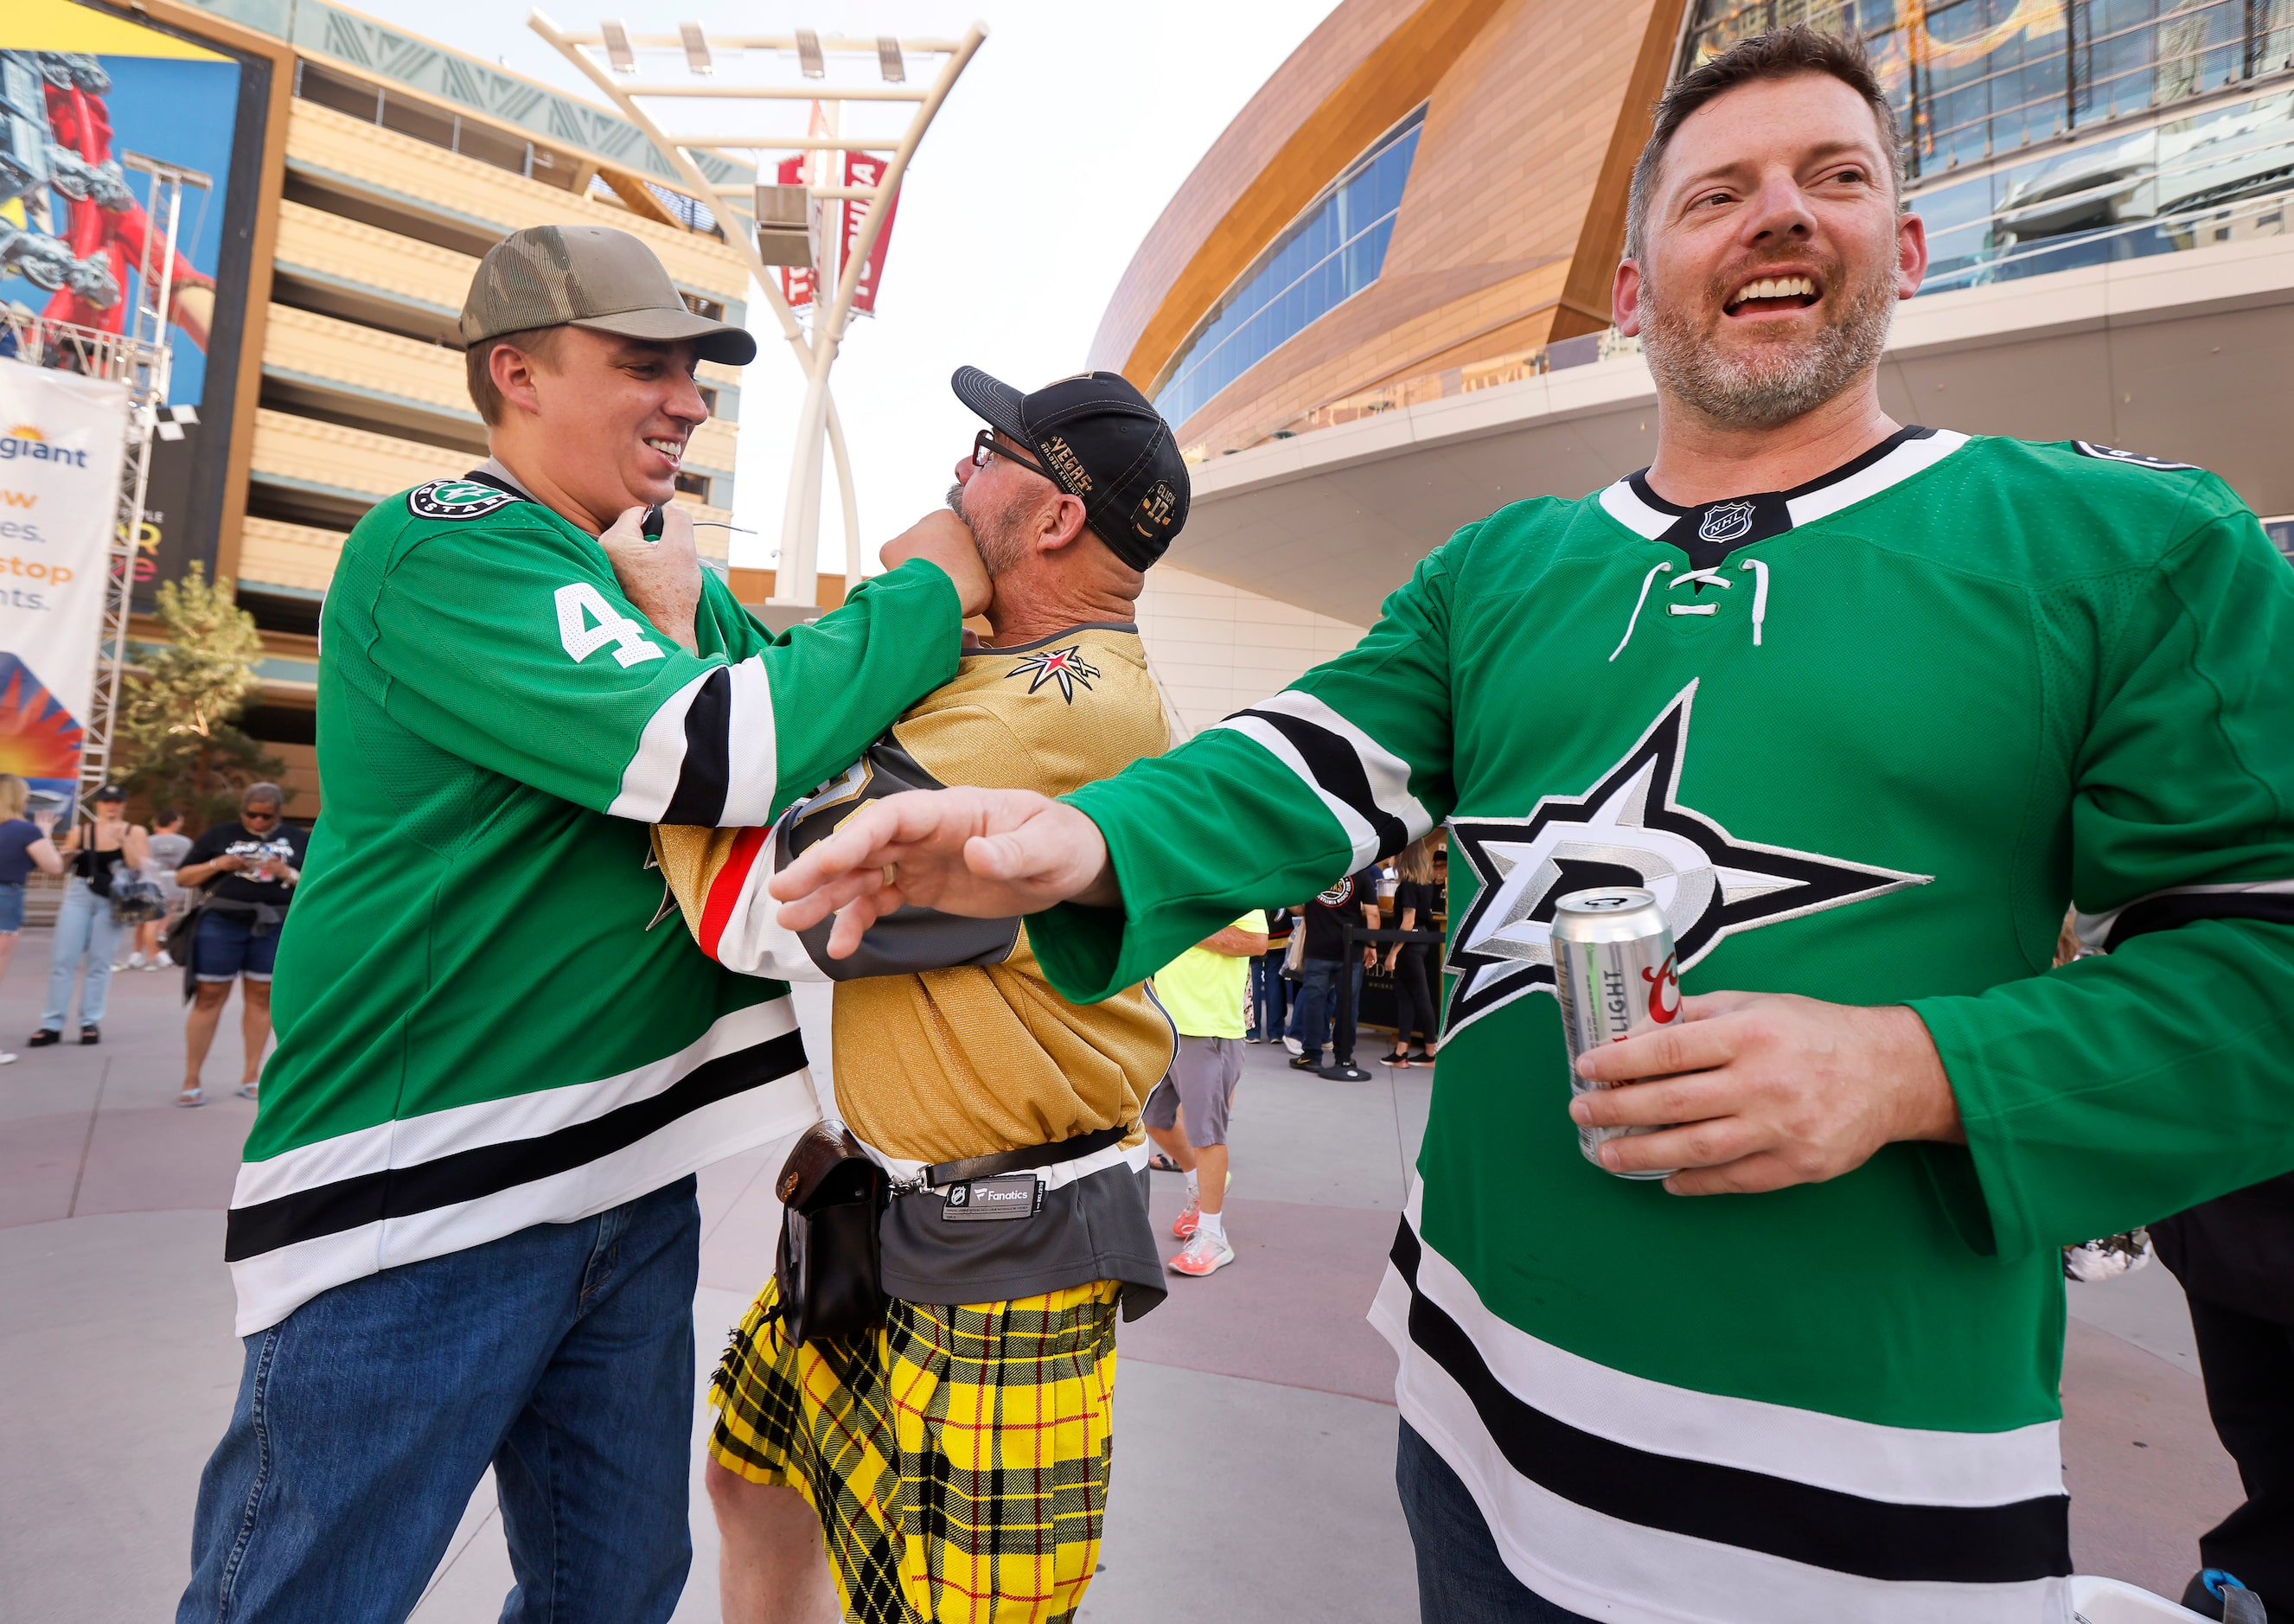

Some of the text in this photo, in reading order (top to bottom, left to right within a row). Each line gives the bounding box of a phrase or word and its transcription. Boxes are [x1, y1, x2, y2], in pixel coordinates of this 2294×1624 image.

[1040, 442, 1059, 470] GOLDEN
[1051, 437, 1093, 490] VEGAS
[1156, 483, 1177, 507] CLICK
[1147, 496, 1169, 524] 17
[1709, 512, 1742, 534] NHL
[553, 582, 666, 669] 4
[1603, 970, 1629, 1033] LIGHT
[987, 1190, 1028, 1201] Fanatics
